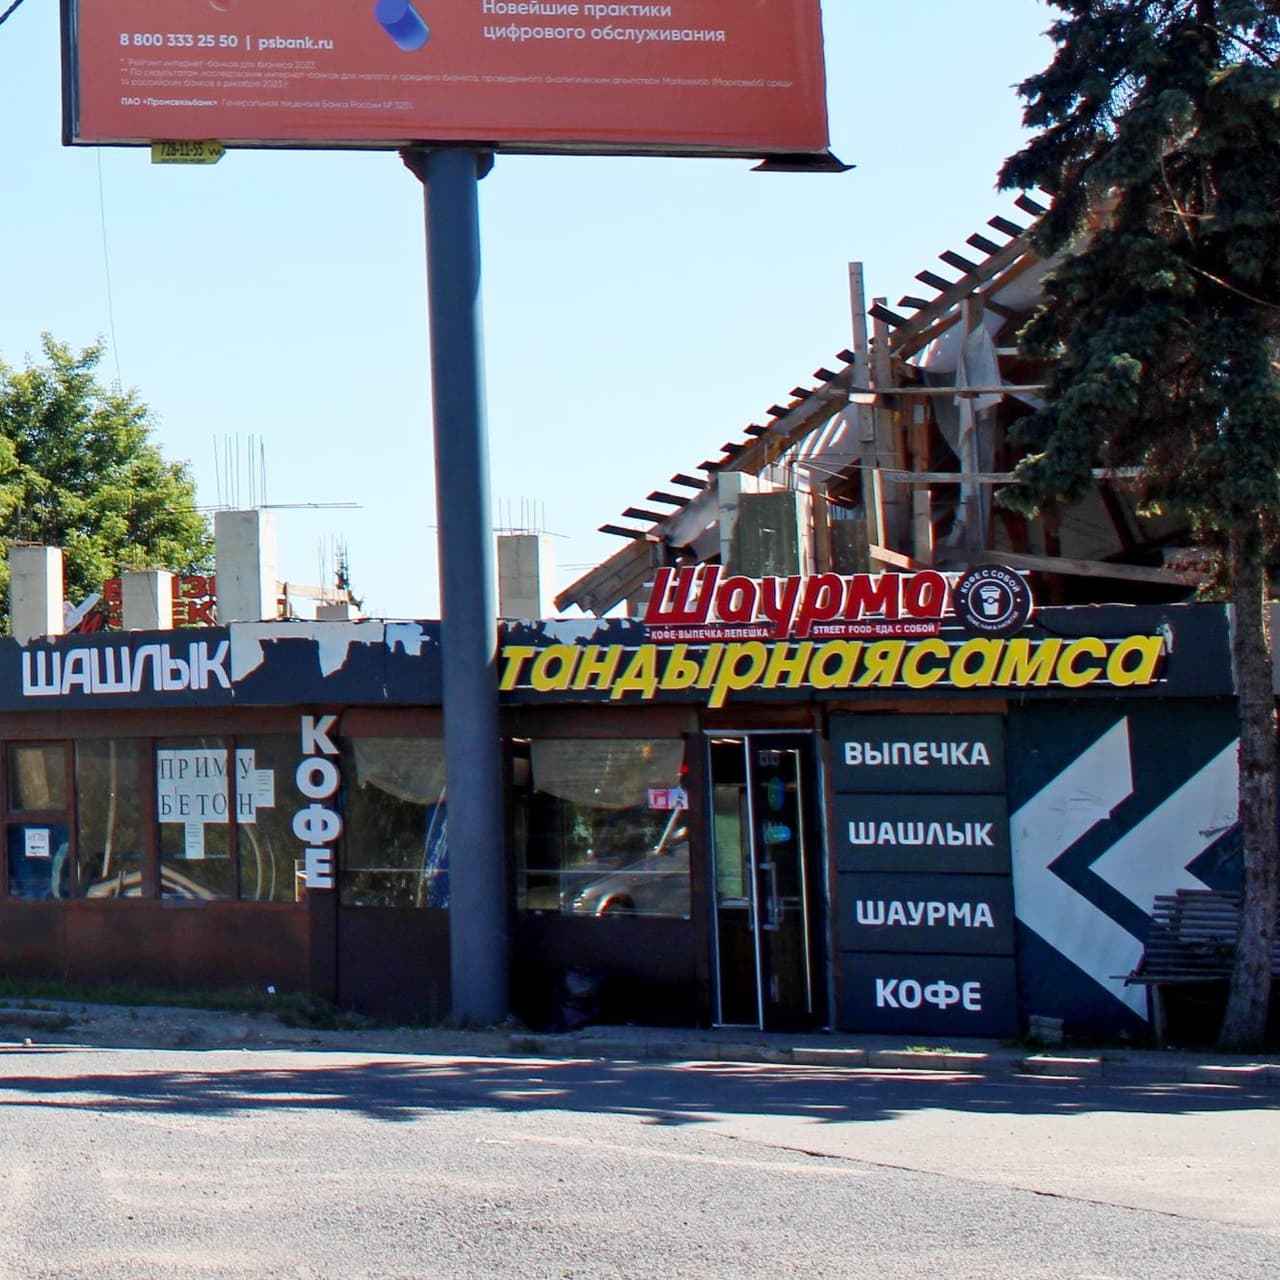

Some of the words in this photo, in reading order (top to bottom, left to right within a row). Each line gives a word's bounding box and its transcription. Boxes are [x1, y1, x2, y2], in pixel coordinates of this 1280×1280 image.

[482, 0, 579, 16] Новейшие
[584, 2, 672, 19] практики
[120, 33, 129, 46] 8
[133, 33, 163, 46] 800
[167, 34, 193, 47] 333
[197, 34, 215, 47] 25
[219, 35, 238, 47] 50
[258, 36, 333, 51] psbank.ru
[484, 24, 586, 41] цифрового
[591, 25, 726, 44] обслуживания
[121, 97, 141, 106] ПАО
[960, 572, 981, 594] КОФЕ
[813, 624, 845, 634] STREET
[895, 624, 901, 632] С
[904, 623, 936, 633] СОБОЙ
[21, 640, 233, 697] ШАШЛЫК
[844, 741, 991, 767] ВЫПЕЧКА
[160, 757, 253, 780] ПРИМУ
[161, 793, 254, 816] БЕТОН
[292, 714, 342, 889] КОФЕ
[848, 821, 994, 847] ШАШЛЫК
[856, 900, 994, 928] ШАУРМА
[875, 978, 982, 1012] КОФЕ
